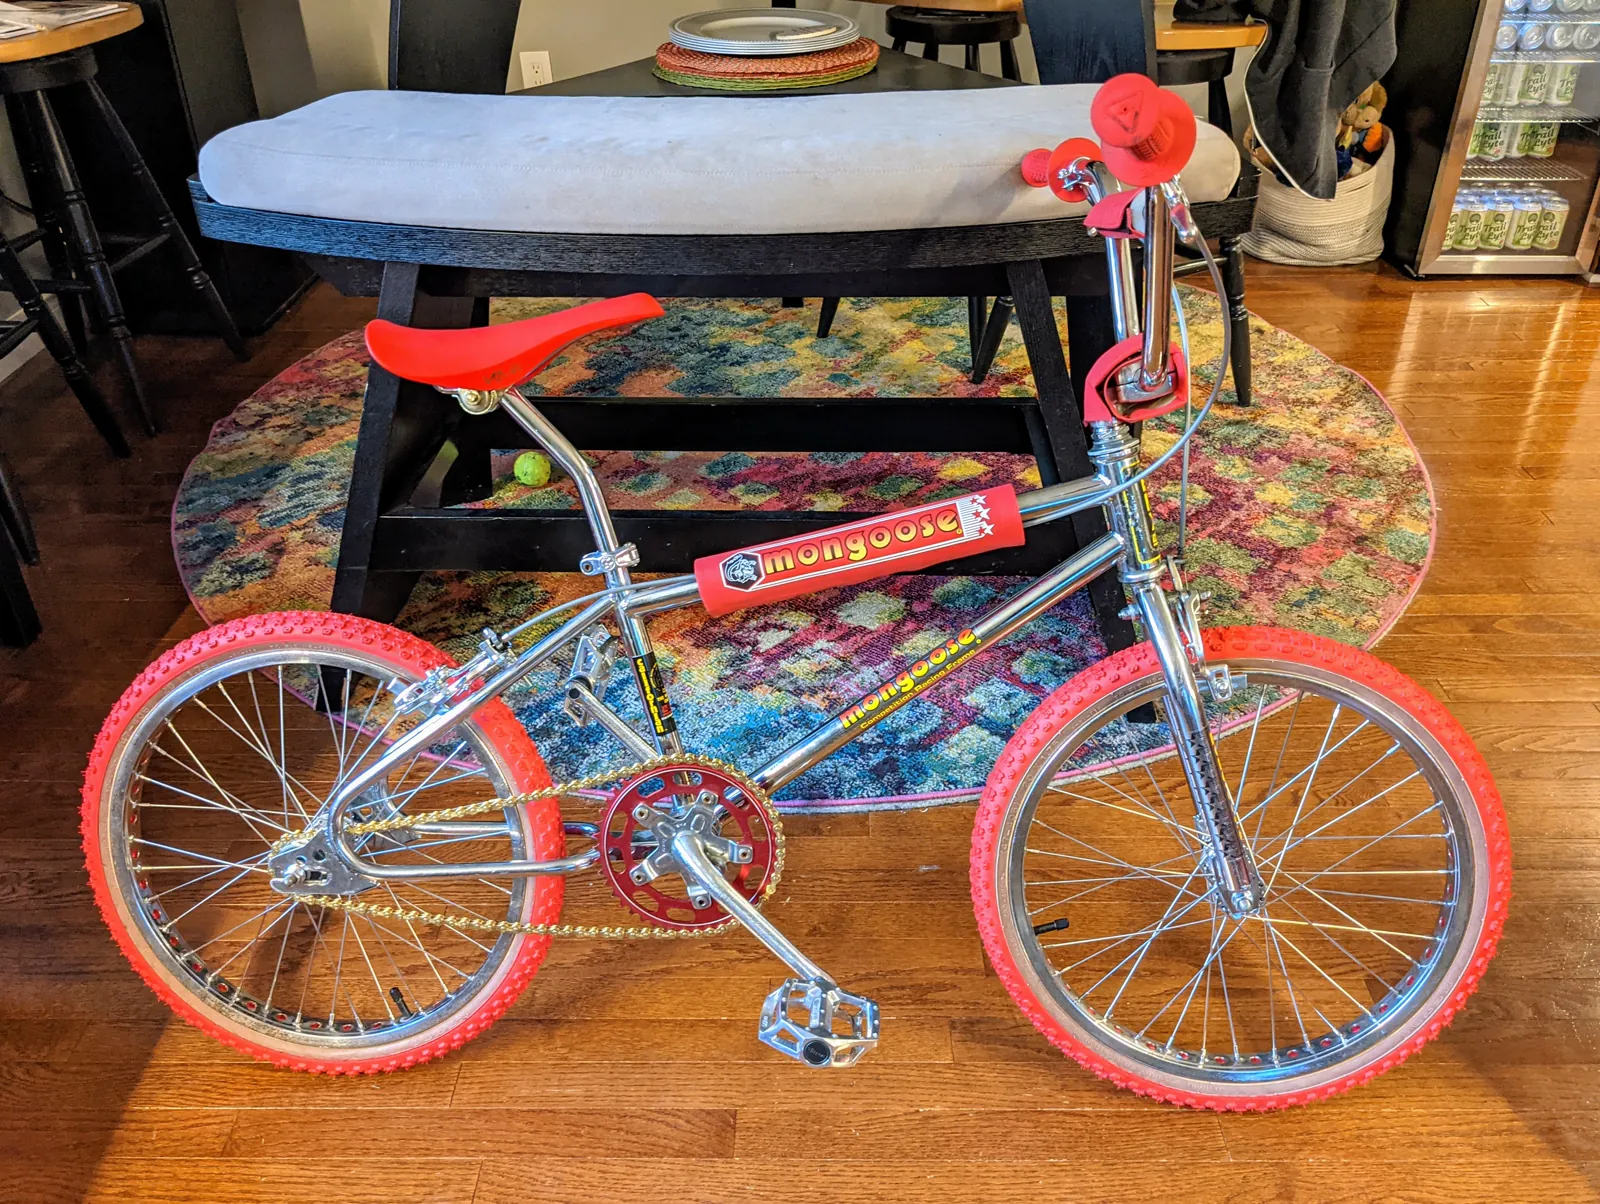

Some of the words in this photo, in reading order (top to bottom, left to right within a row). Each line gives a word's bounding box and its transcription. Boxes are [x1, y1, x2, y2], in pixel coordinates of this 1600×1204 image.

[1463, 232, 1480, 242] Lyt
[1540, 222, 1557, 231] rail
[762, 509, 959, 575] mongoose
[839, 628, 976, 729] mongoose
[860, 692, 915, 730] Competition
[914, 669, 946, 693] Racing
[945, 649, 976, 670] Frame
